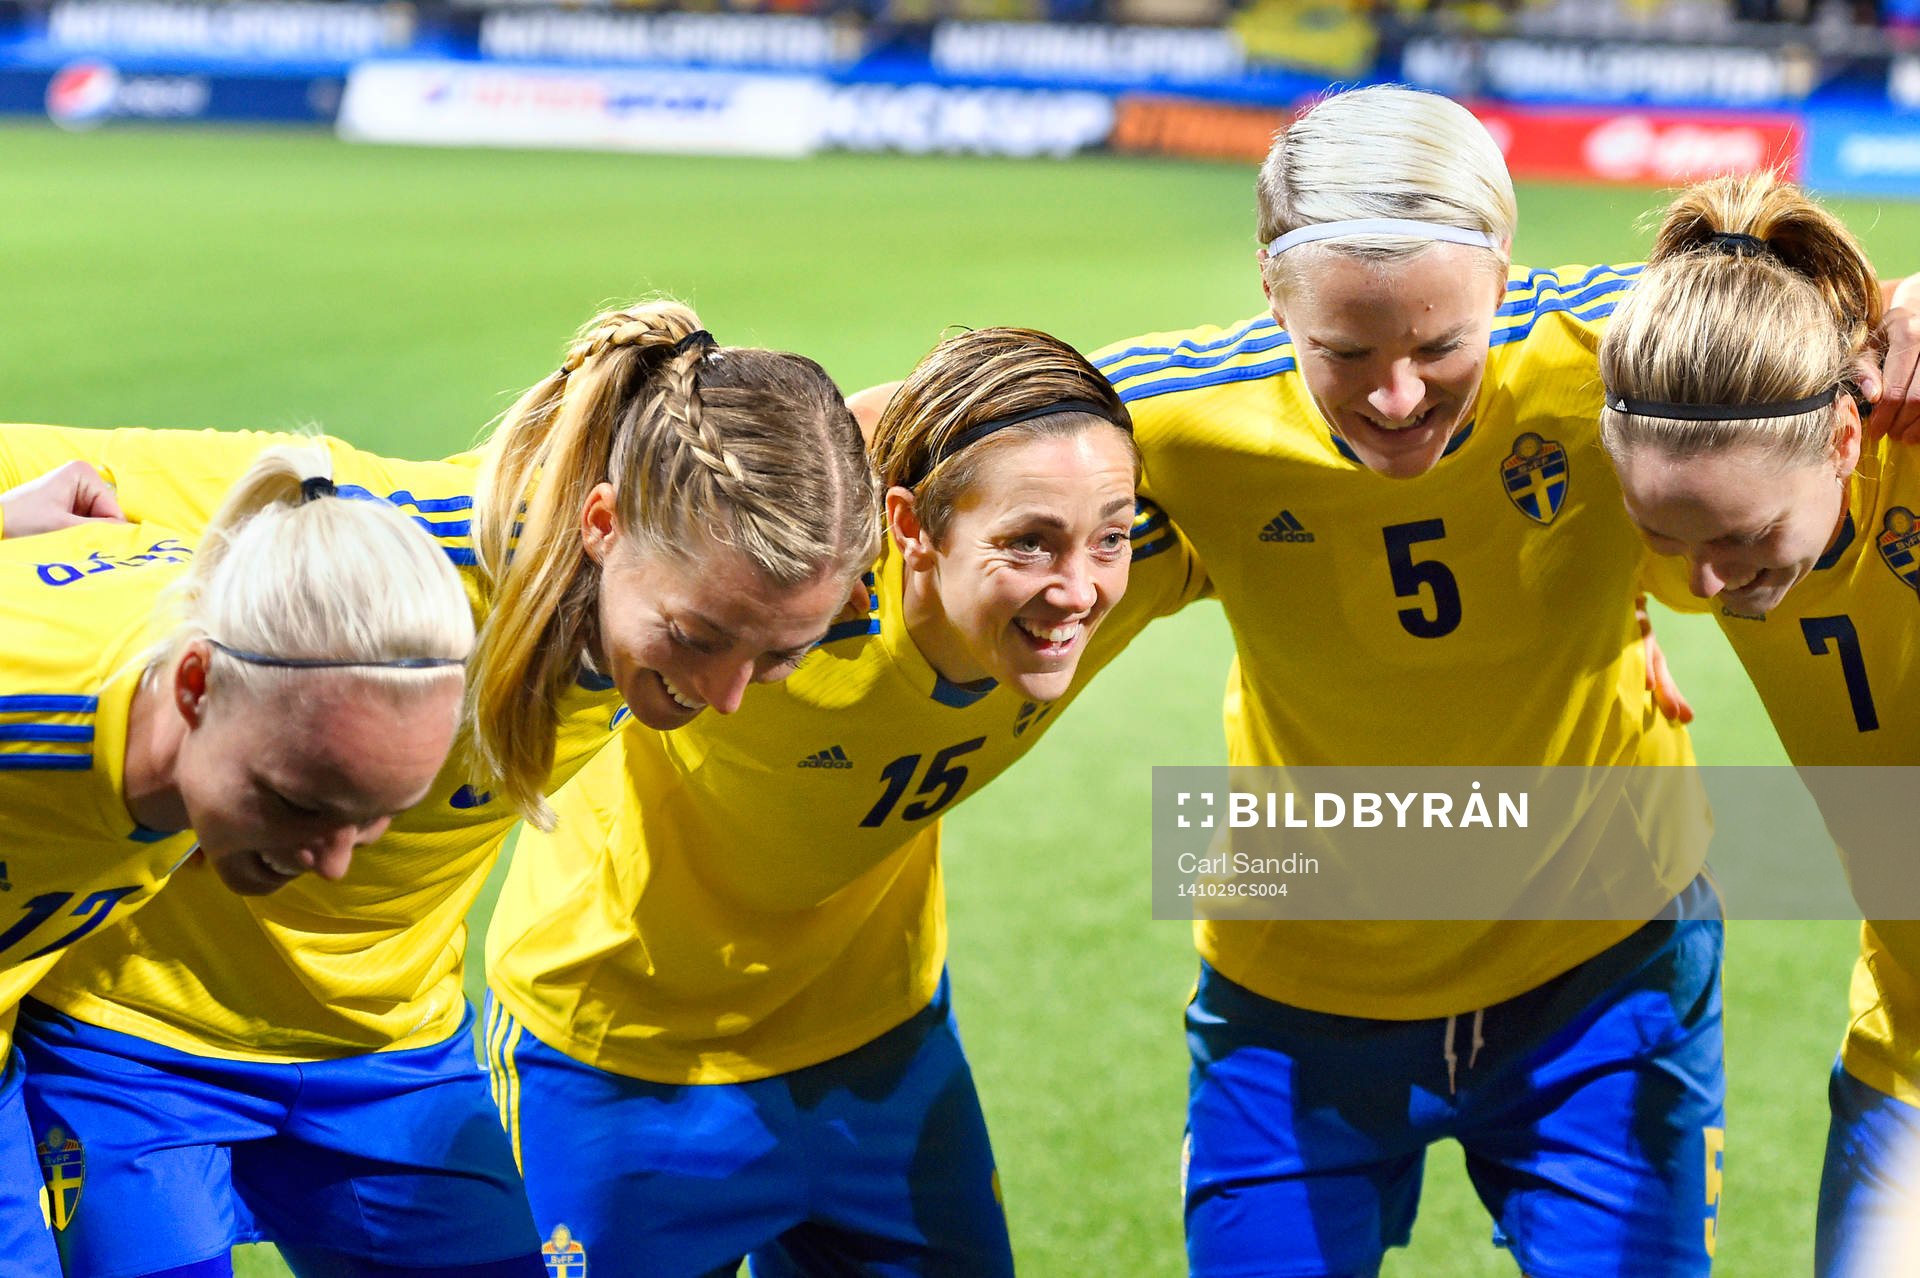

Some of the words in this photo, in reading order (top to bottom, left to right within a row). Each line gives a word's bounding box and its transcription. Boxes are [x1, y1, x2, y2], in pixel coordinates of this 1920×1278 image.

[1258, 530, 1315, 543] adidas
[1382, 518, 1462, 638] 5
[1800, 614, 1879, 732] 7
[797, 757, 853, 769] adidas
[858, 736, 987, 827] 15
[0, 884, 144, 962] 17
